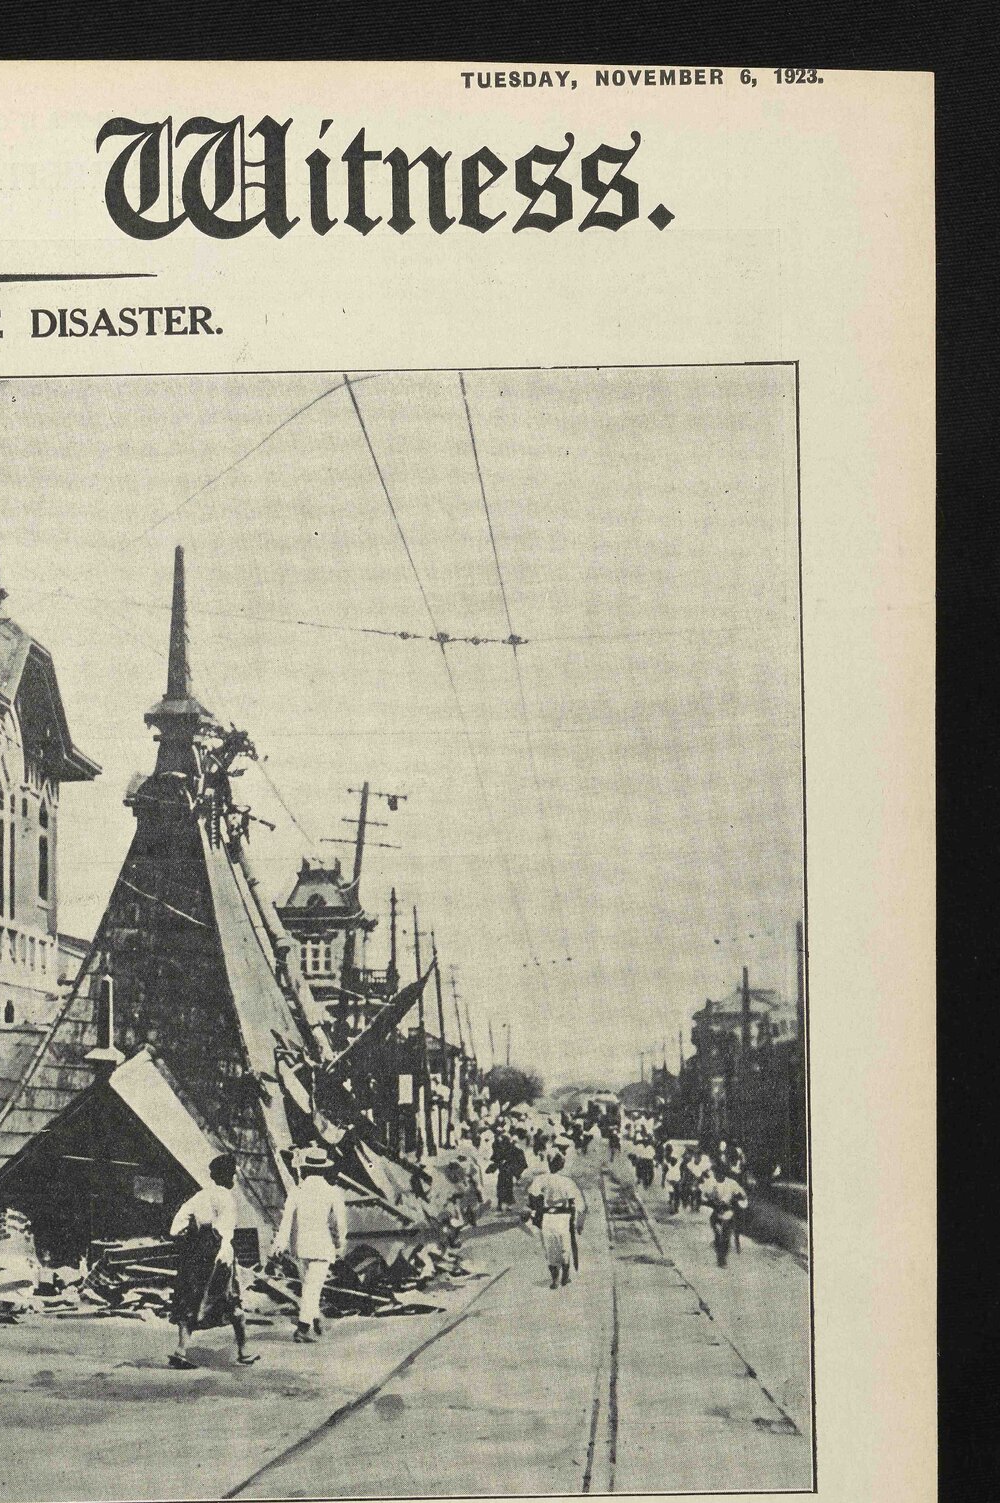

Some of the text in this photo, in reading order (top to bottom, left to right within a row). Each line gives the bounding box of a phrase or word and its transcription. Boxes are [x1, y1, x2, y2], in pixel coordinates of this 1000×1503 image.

[461, 68, 824, 90] TUESDAY, NOVEMBER 6, 1923.
[95, 114, 676, 241] Witness.
[30, 307, 225, 339] DISASTER.
